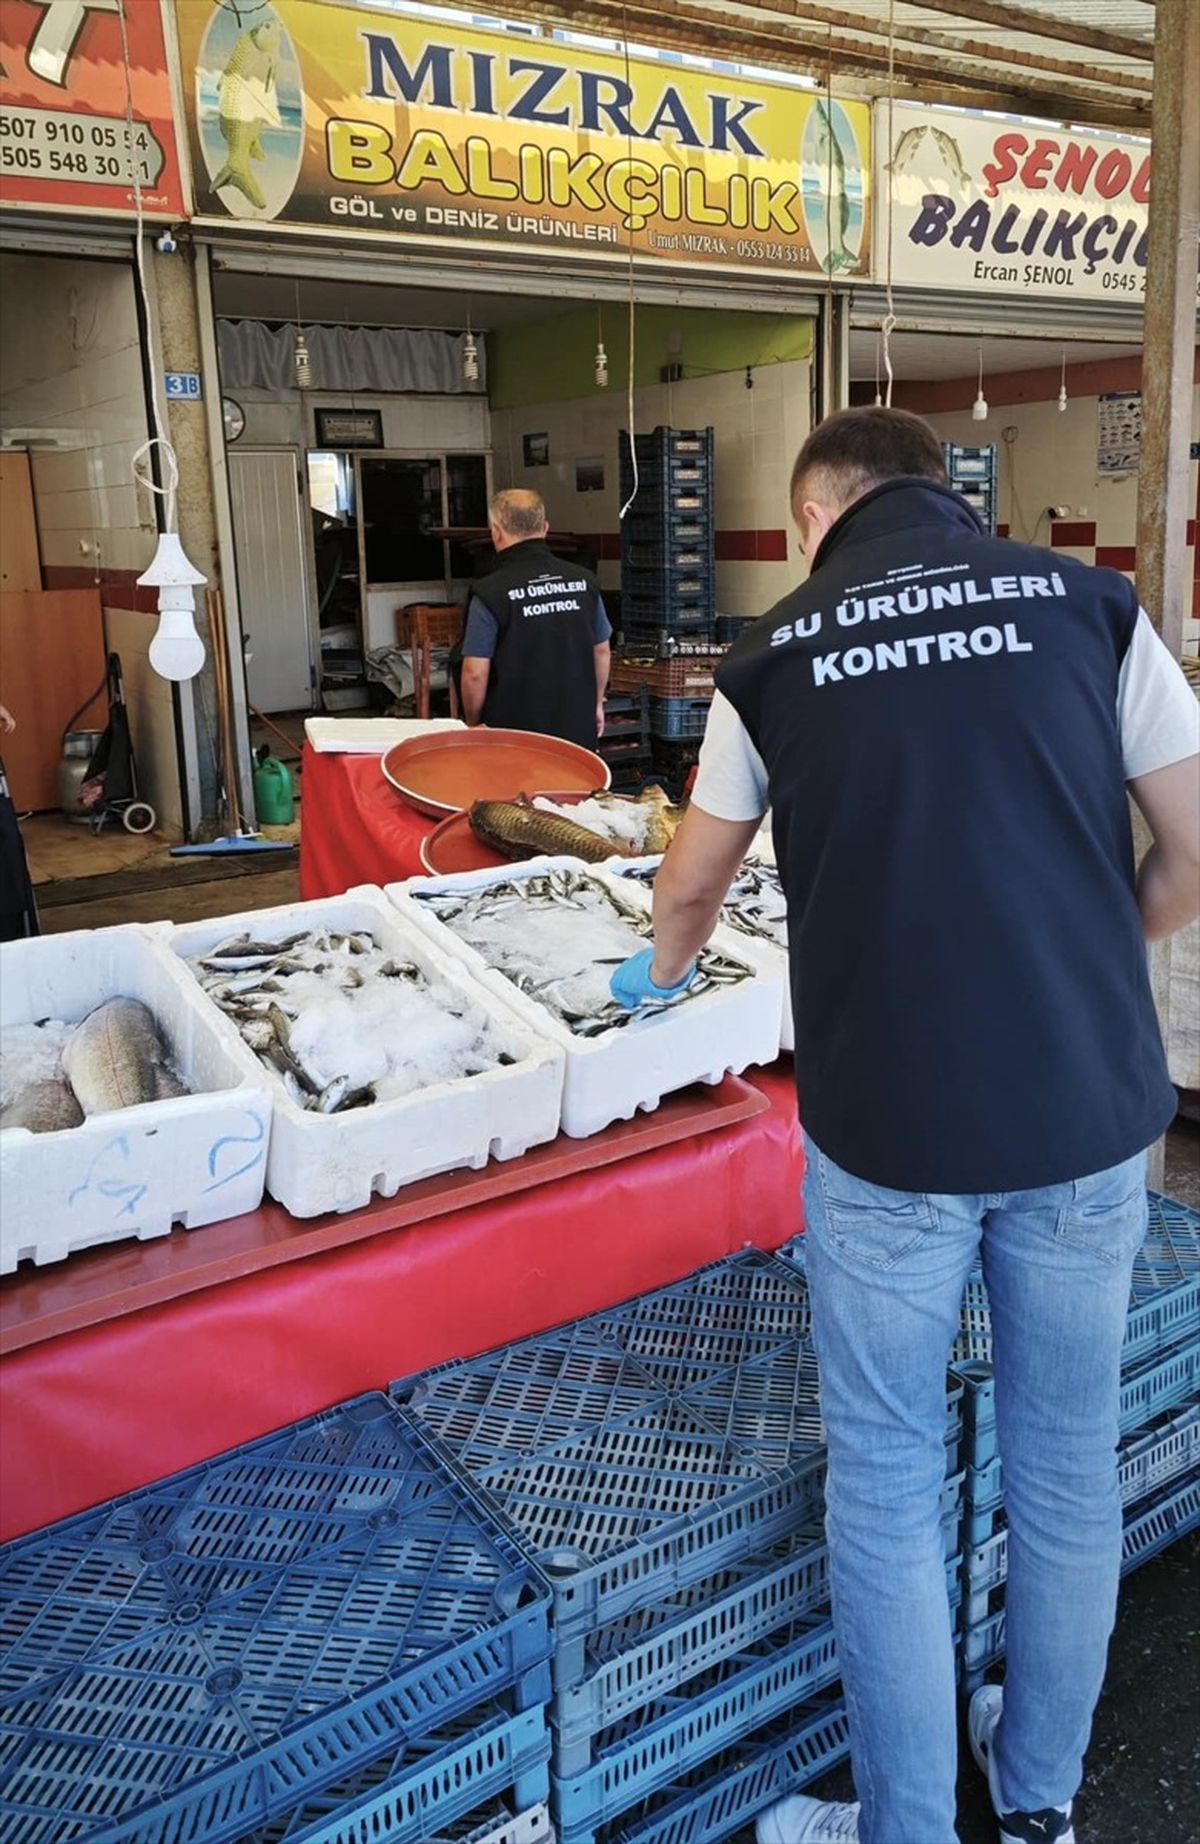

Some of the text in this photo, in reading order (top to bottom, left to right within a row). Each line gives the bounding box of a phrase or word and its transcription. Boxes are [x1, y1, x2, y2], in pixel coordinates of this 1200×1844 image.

[360, 31, 765, 157] MIZRAK
[45, 121, 84, 144] 910
[91, 127, 116, 147] 05
[0, 146, 42, 170] 505
[50, 151, 88, 173] 548
[95, 156, 120, 176] 30
[325, 117, 800, 234] BALIKÇILIK
[330, 195, 618, 243] GÖL ve DENİZ ÜRÜNLERİ
[647, 229, 679, 249] Umut
[681, 233, 728, 255] MIZRAK
[736, 239, 765, 259] 0553
[974, 260, 1018, 282] Ercan
[1023, 264, 1075, 288] ŞENOL
[1102, 271, 1137, 292] 0545
[168, 376, 198, 393] 3 B
[507, 588, 525, 600] SU
[527, 579, 587, 597] ÜRÜNLERİ
[523, 600, 580, 617] KONTROL
[770, 611, 822, 647] SU
[836, 571, 1067, 627] ÜRÜNLERİ
[812, 623, 1033, 687] KONTROL
